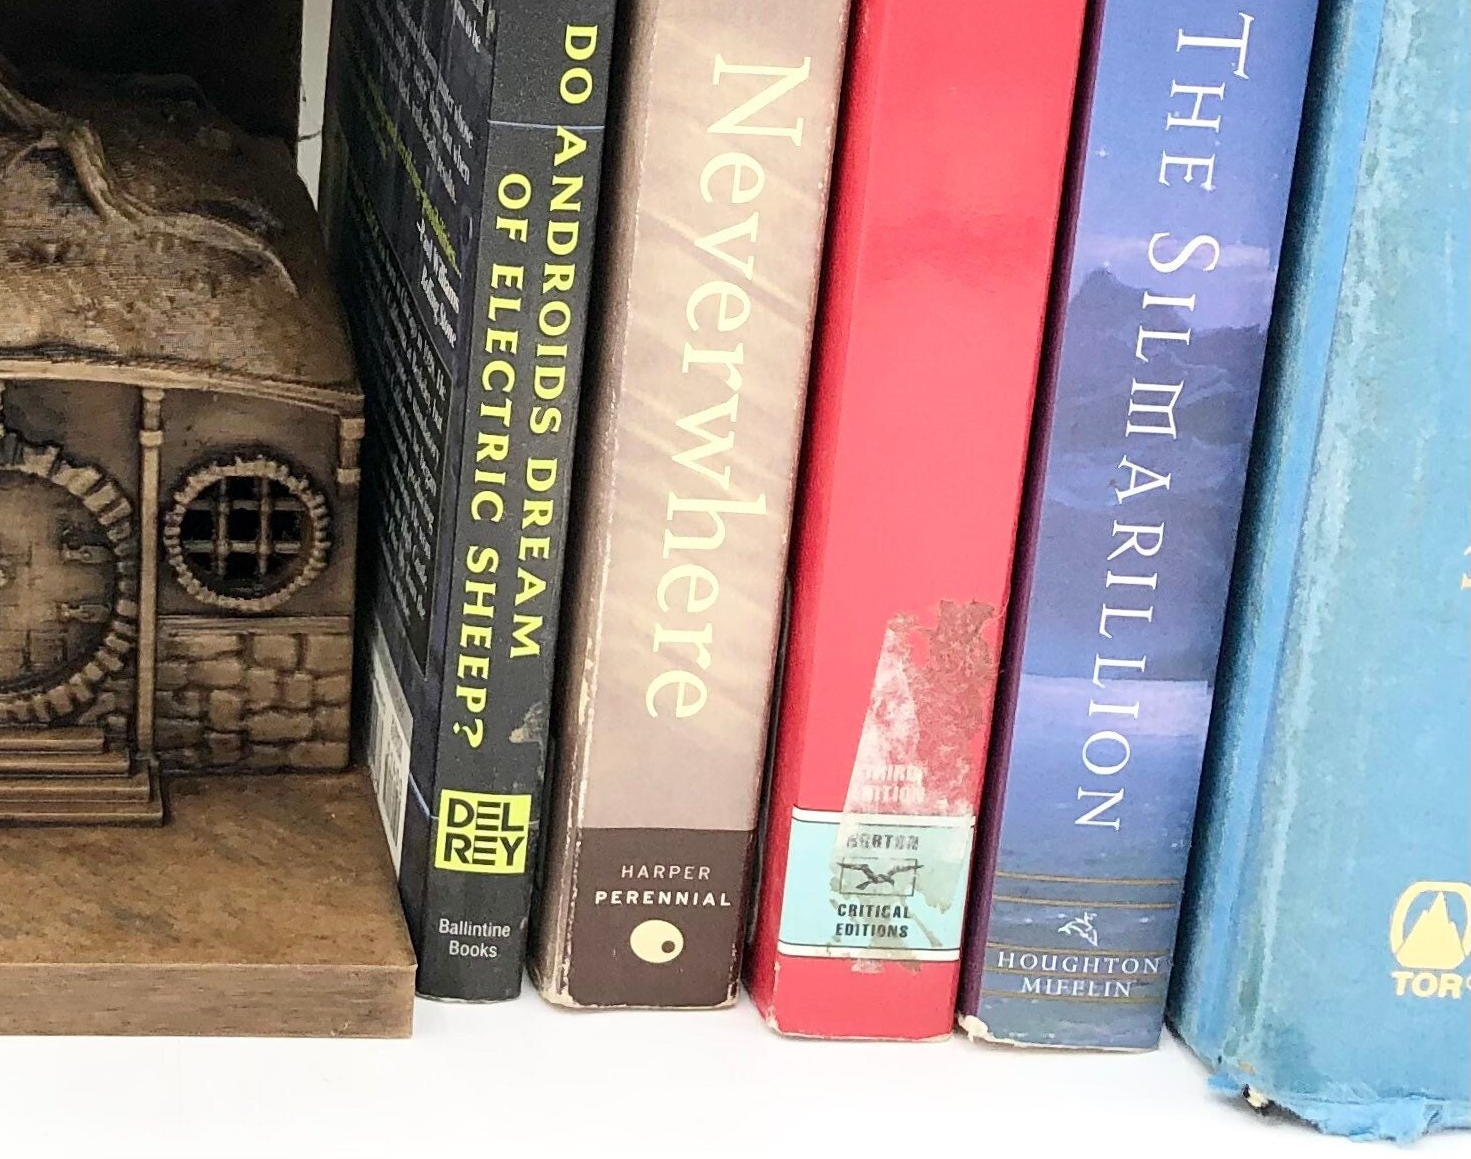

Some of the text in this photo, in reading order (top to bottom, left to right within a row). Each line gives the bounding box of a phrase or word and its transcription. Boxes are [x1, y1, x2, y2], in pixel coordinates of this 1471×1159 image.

[509, 23, 600, 660] DO ANDROIDS DREAM
[645, 52, 813, 720] Neverwhere
[1074, 11, 1255, 831] THE SILMARILLION
[452, 173, 532, 749] OF ELECTRIC SHEEP?
[446, 797, 525, 832] DEL
[443, 832, 526, 867] REY
[621, 864, 711, 881] HARPER
[594, 890, 731, 908] PERENNIAL
[837, 903, 911, 919] CRITICAL
[835, 922, 909, 938] EDITIONS
[448, 940, 498, 958] Books
[997, 951, 1161, 974] HOUGHTON
[1021, 977, 1132, 998] MIFFLIN
